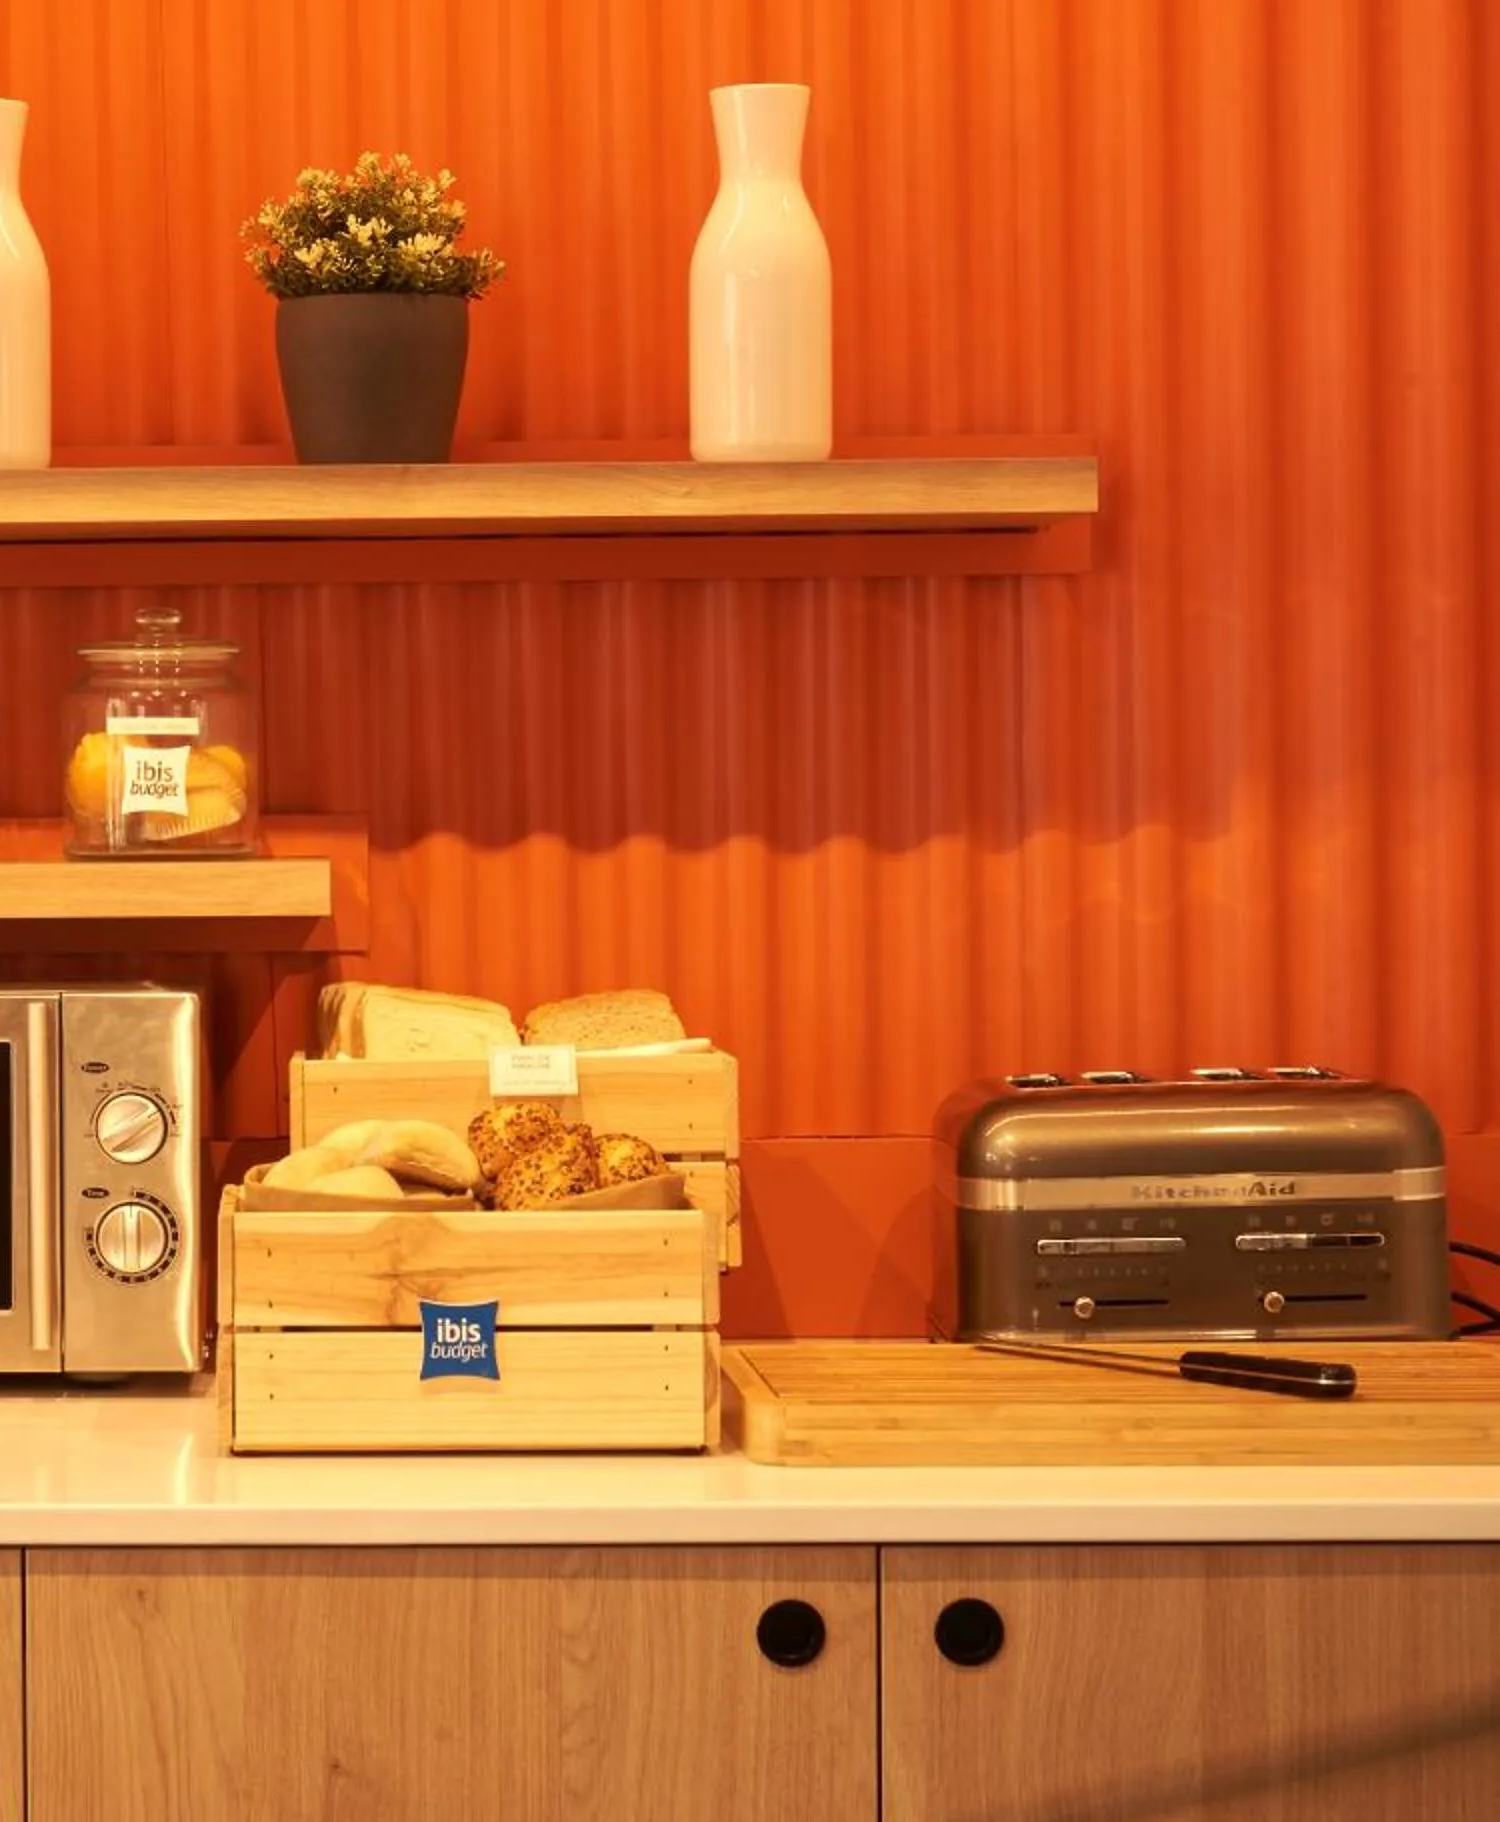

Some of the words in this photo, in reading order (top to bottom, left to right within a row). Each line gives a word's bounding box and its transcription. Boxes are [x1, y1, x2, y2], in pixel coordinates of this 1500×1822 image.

[136, 760, 173, 783] ibis
[129, 779, 179, 799] budget
[1130, 1181, 1296, 1200] KitchenAid
[436, 1317, 481, 1343] ibis
[430, 1341, 488, 1363] budget
